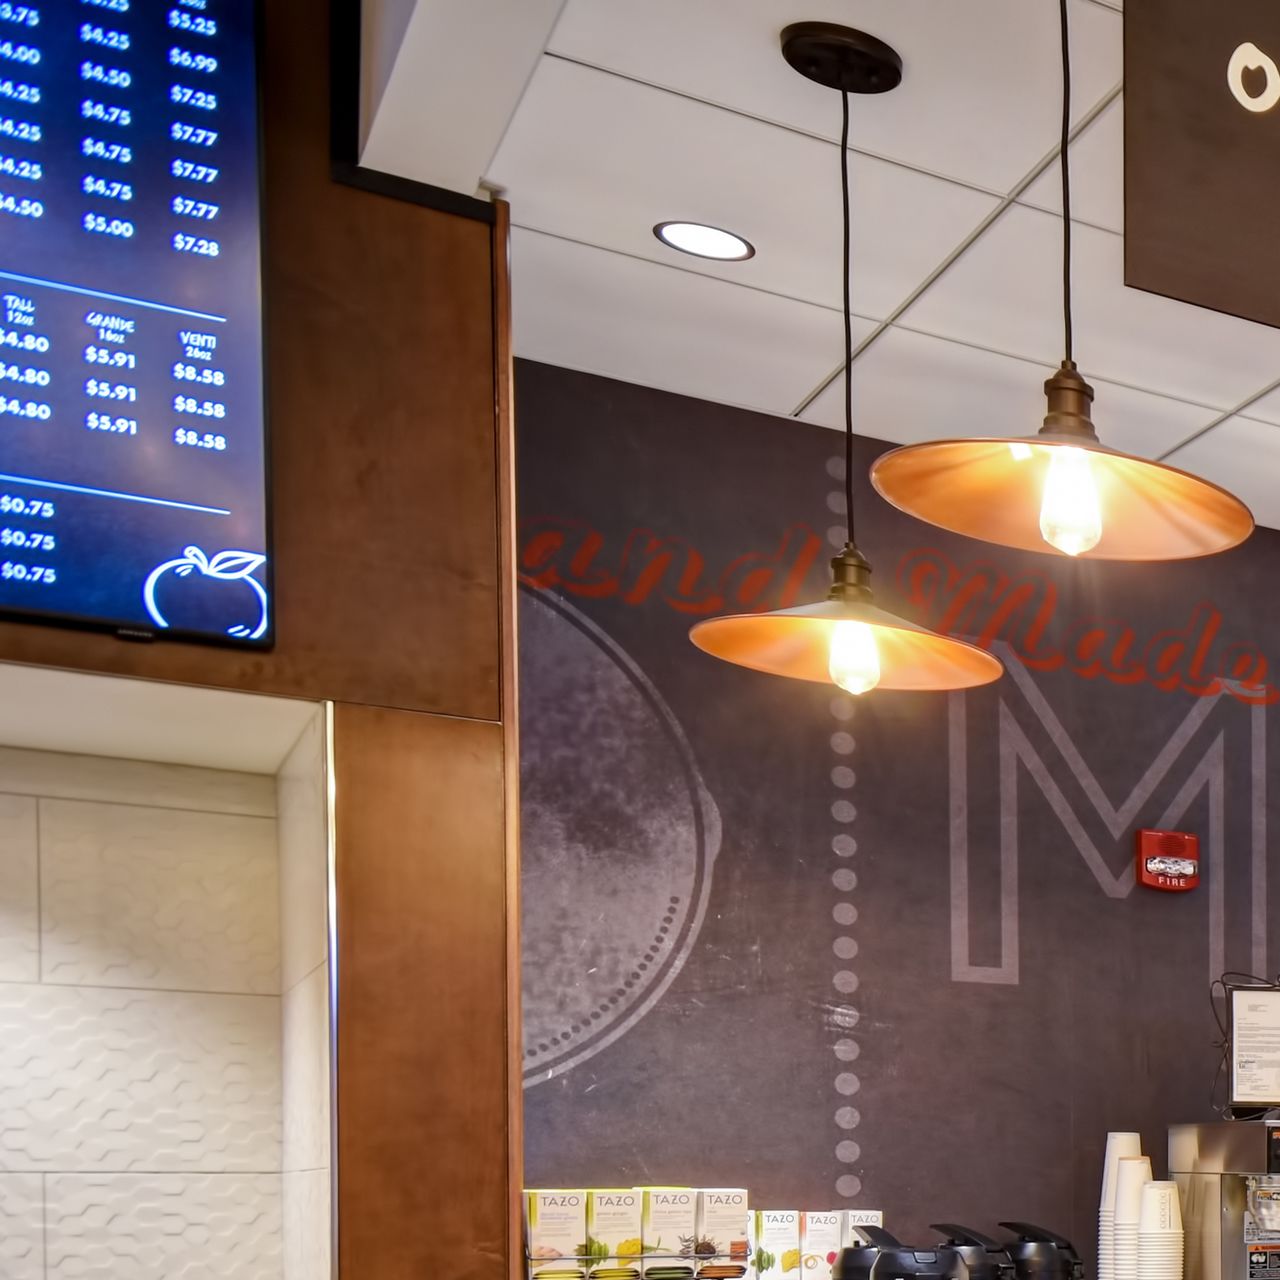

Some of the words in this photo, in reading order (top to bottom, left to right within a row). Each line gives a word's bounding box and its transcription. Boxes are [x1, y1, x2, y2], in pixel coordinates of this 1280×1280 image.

[168, 9, 217, 36] $5.25
[80, 23, 130, 50] $4.25
[169, 47, 217, 73] $6.99
[0, 41, 40, 64] 4.00
[80, 61, 131, 87] $4.50
[171, 84, 216, 110] $7.25
[0, 80, 40, 103] 4.25
[81, 99, 131, 125] $4.75
[171, 122, 217, 146] $7.77
[0, 118, 41, 141] 4.25
[82, 137, 132, 162] $4.75
[172, 159, 218, 183] $7.77
[83, 175, 132, 200] $4.75
[173, 196, 218, 220] $7.77
[84, 212, 134, 237] $5.00
[173, 233, 219, 256] $7.28
[180, 331, 216, 349] VENTI
[85, 345, 136, 369] $5.91
[173, 362, 225, 386] $8.58
[86, 378, 136, 402] $5.91
[174, 395, 226, 418] $8.58
[86, 412, 137, 435] $5.91
[174, 428, 226, 450] $8.58
[1, 528, 55, 551] $0.75
[1, 561, 56, 584] $0.75
[899, 546, 1280, 706] Made
[1158, 876, 1187, 888] FIRE
[542, 1195, 580, 1207] TAZO
[597, 1195, 635, 1206] TAZO
[653, 1194, 690, 1205] TAZO
[707, 1194, 743, 1205] TAZO
[766, 1214, 794, 1223] TAZO
[810, 1216, 838, 1225] TAZO
[851, 1214, 879, 1224] TAZO
